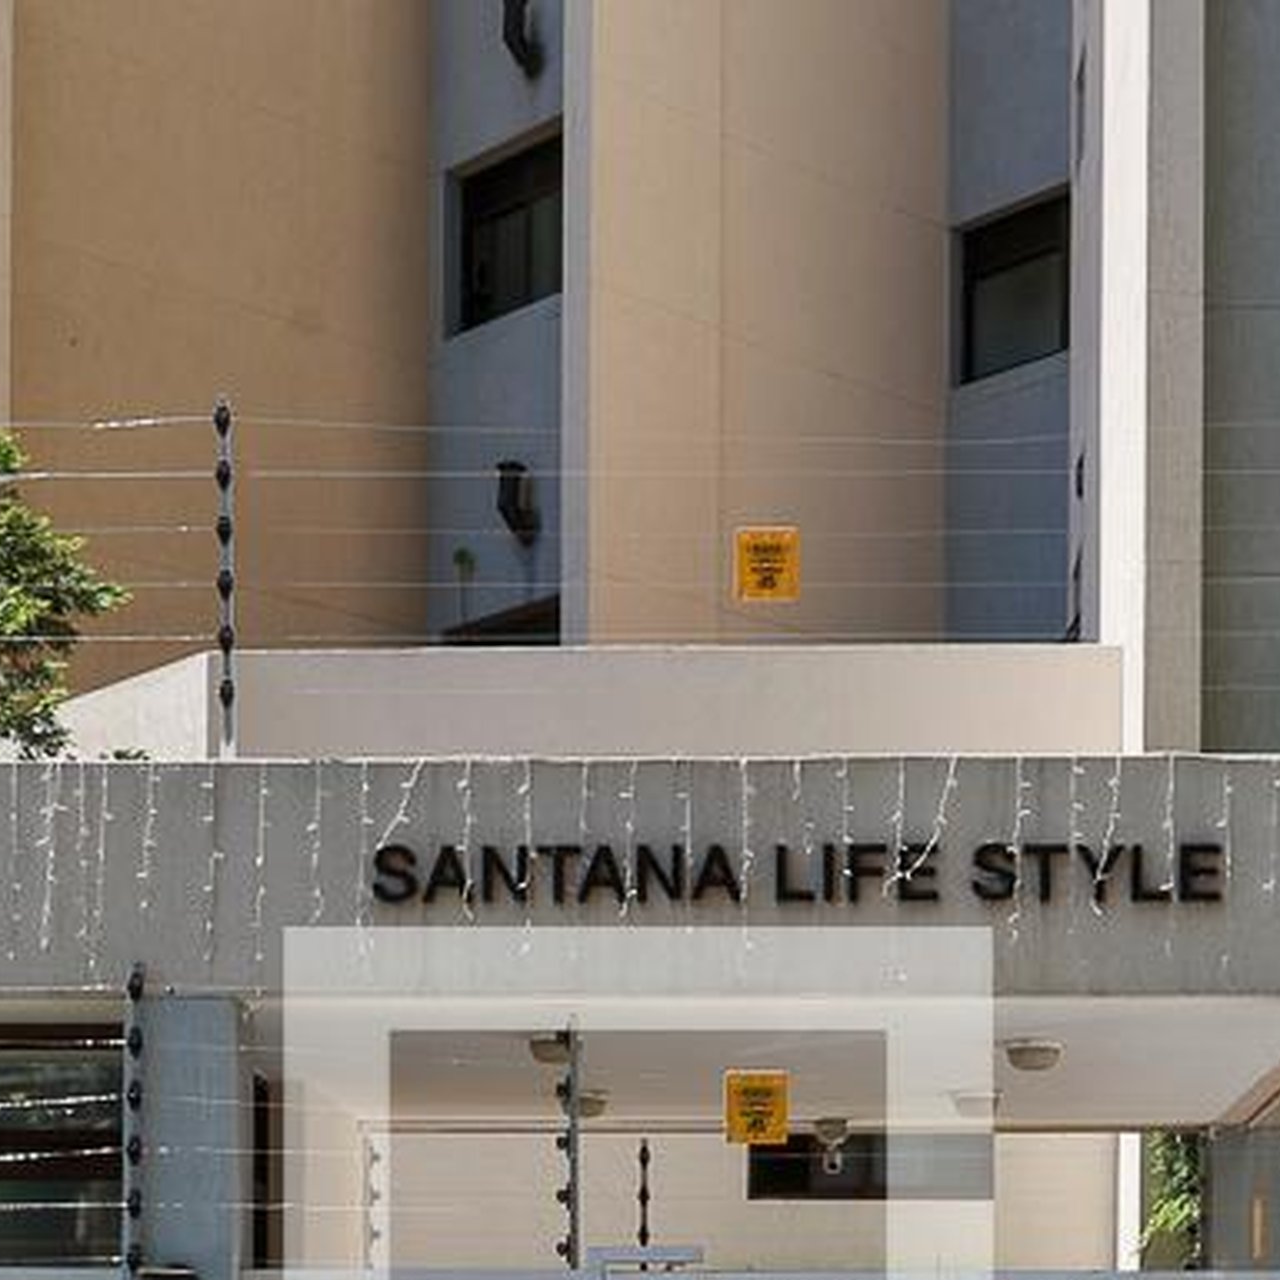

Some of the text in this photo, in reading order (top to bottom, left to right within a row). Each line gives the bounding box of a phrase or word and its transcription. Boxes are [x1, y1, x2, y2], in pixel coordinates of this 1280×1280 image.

[372, 841, 1224, 905] SANTANA LIFE STYLE
